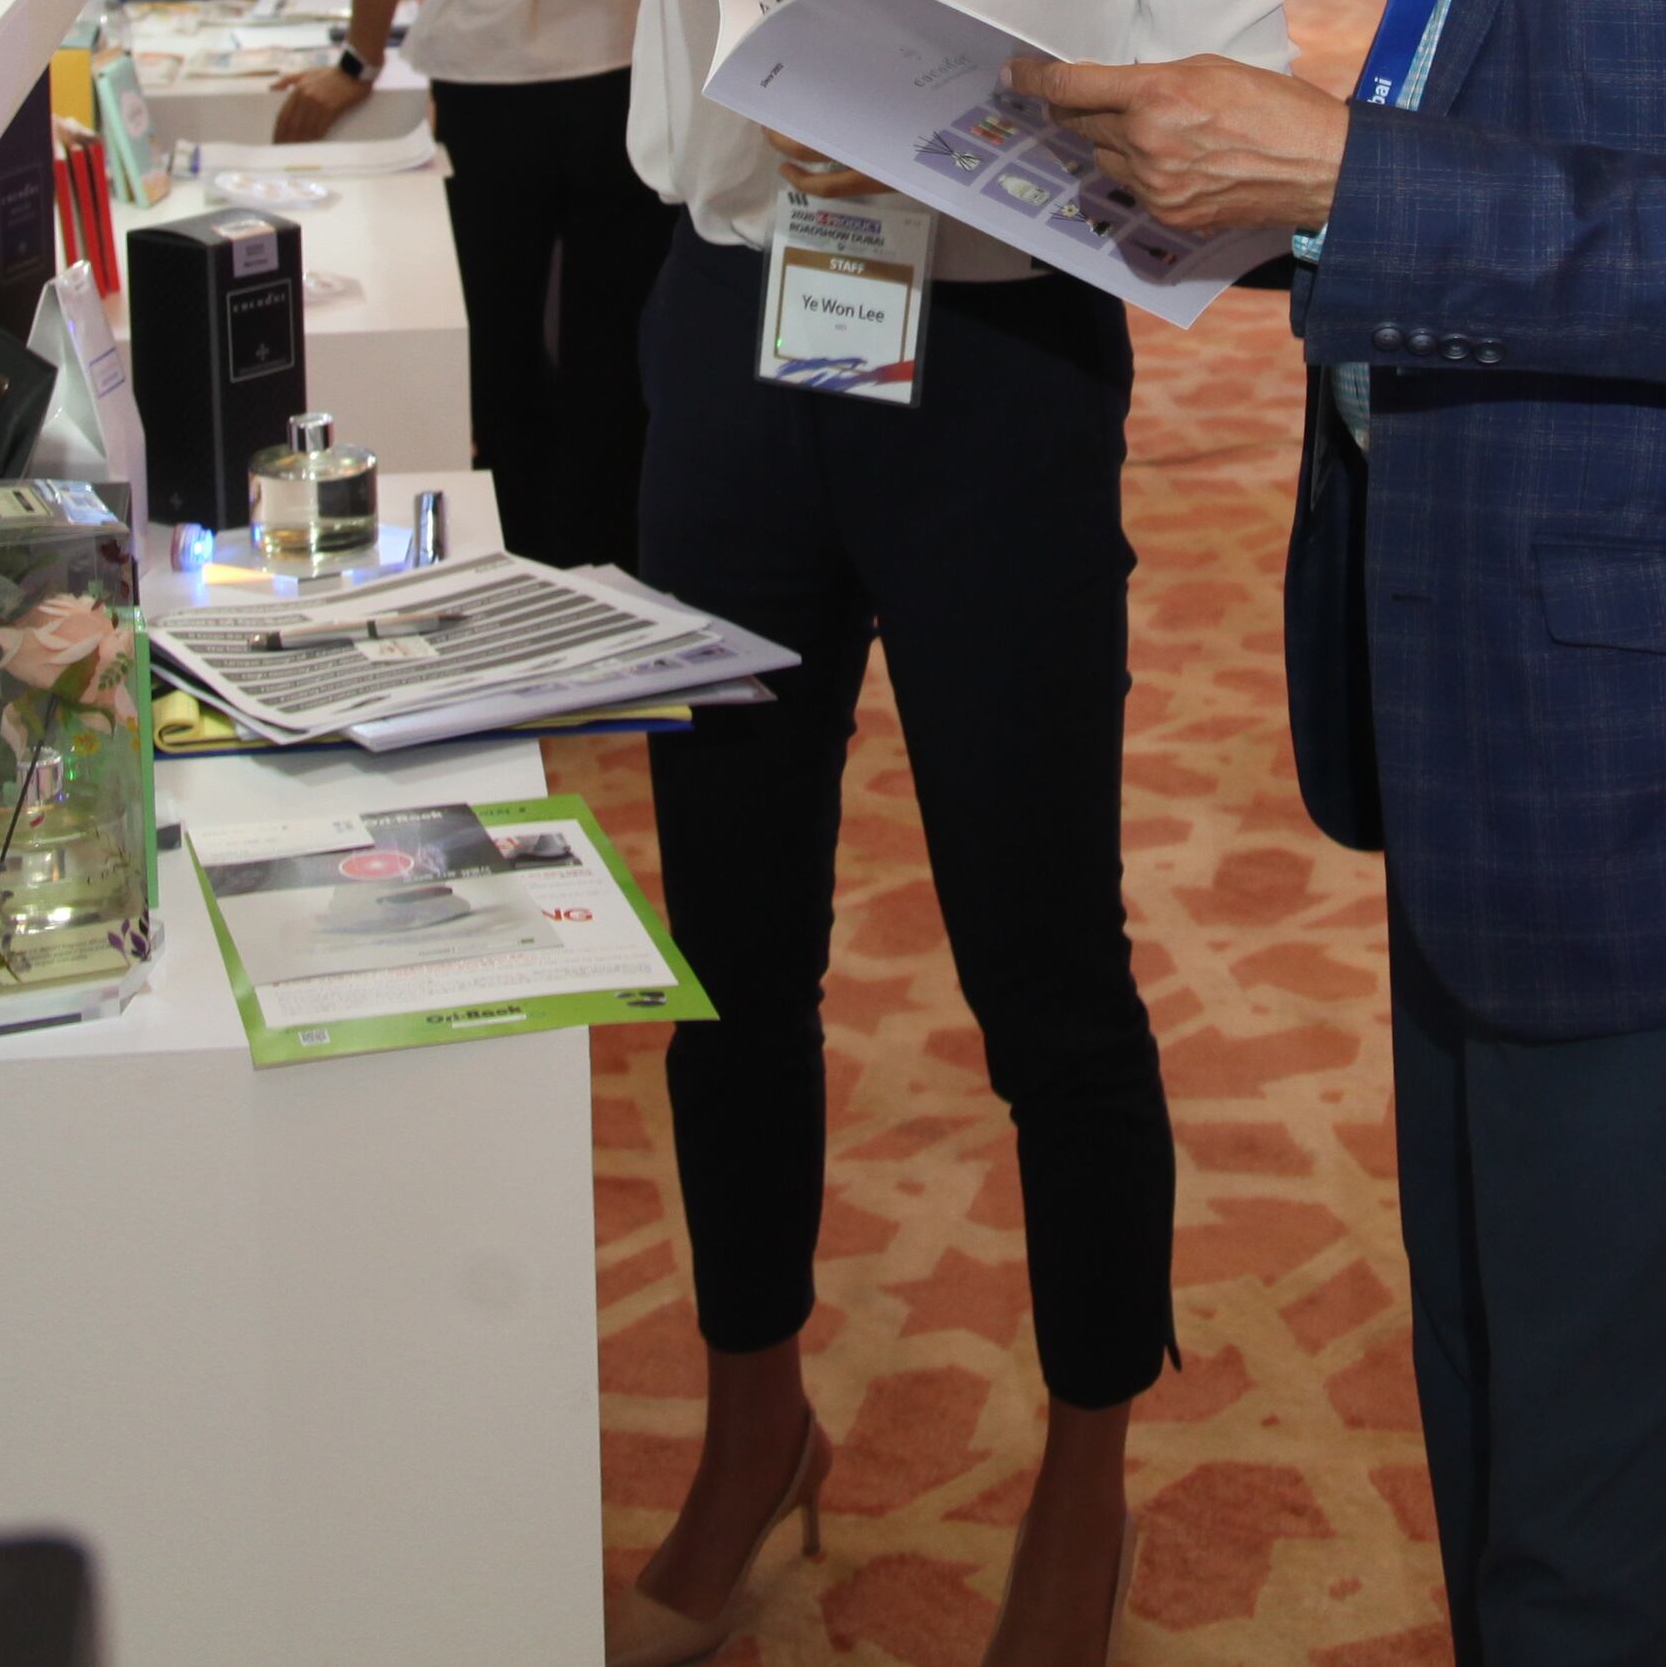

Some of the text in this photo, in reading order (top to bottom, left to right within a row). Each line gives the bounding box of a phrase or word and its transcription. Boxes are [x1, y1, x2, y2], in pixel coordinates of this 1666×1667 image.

[829, 258, 865, 274] STAFF
[802, 294, 886, 323] Ye Won Lee
